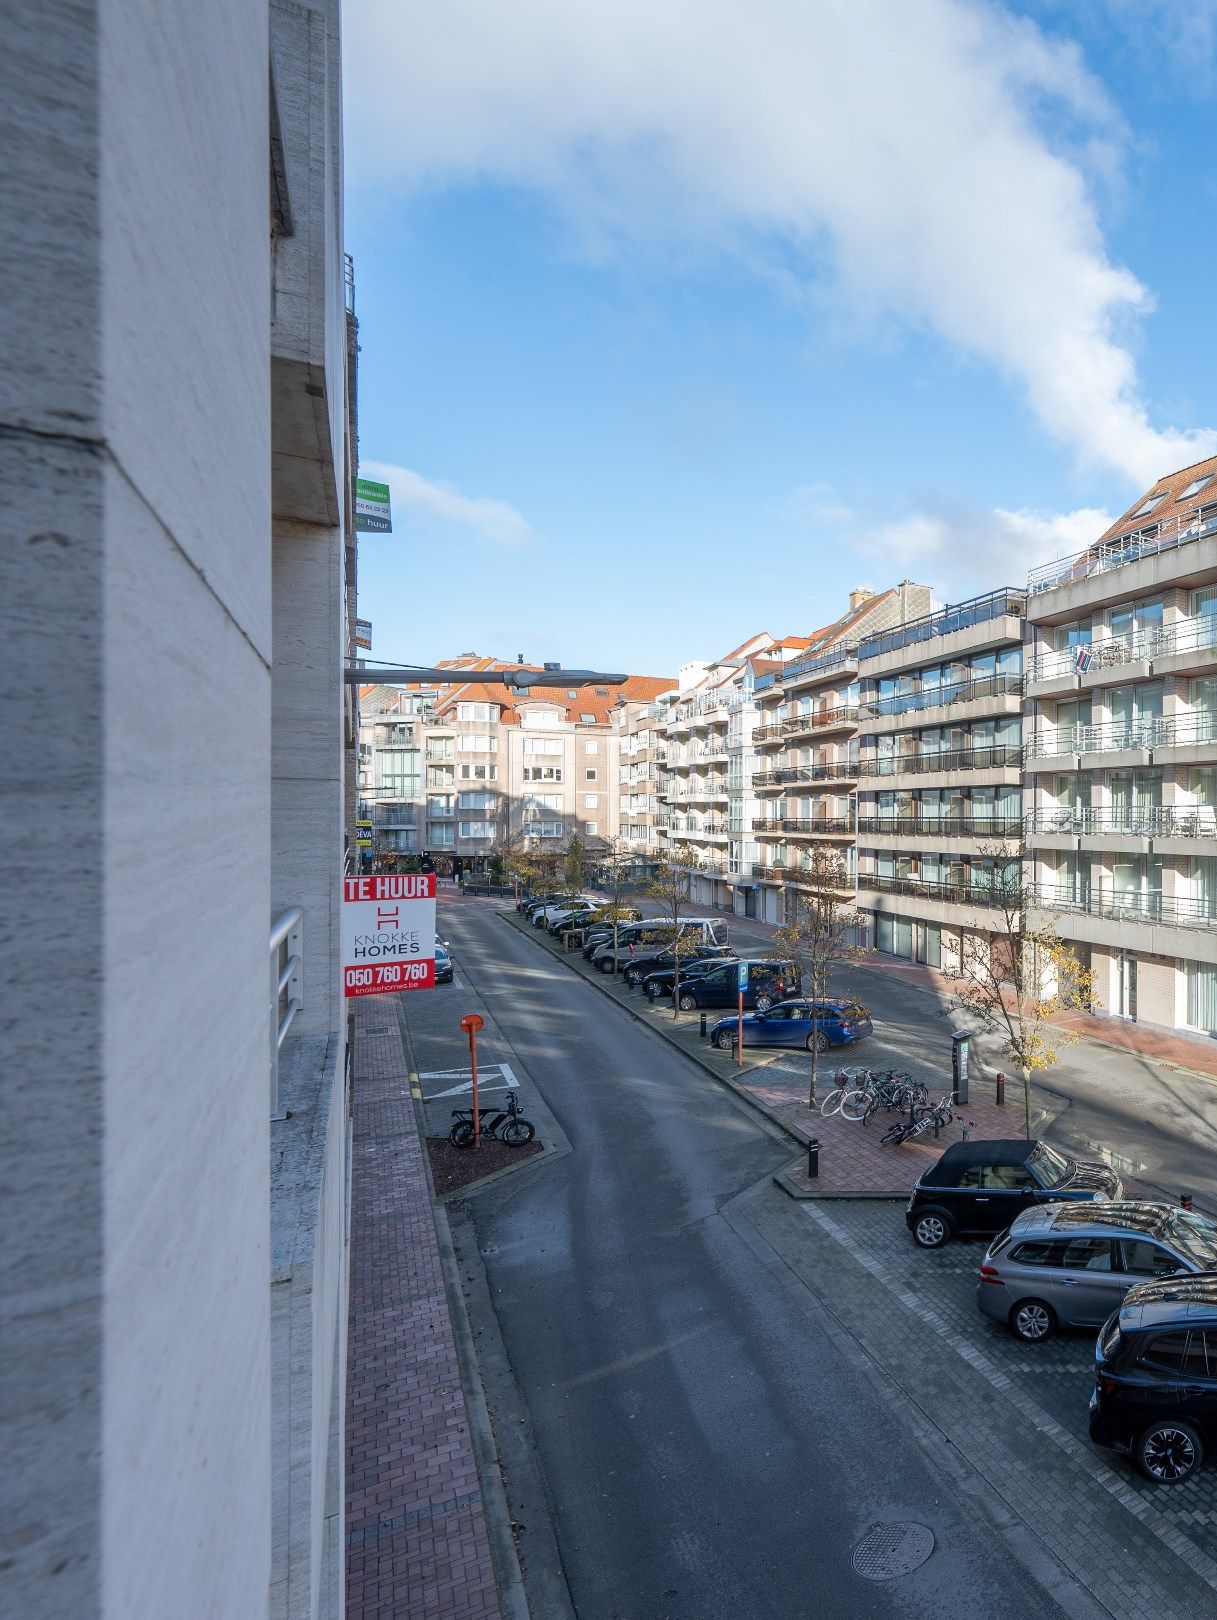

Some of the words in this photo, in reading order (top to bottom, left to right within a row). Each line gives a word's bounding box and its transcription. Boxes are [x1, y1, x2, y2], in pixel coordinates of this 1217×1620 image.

[367, 518, 388, 528] huur
[345, 877, 371, 900] TE
[376, 876, 429, 899] HUUR
[354, 930, 420, 946] KNOKKE
[354, 942, 420, 959] HOMES
[346, 968, 373, 988] 050
[375, 965, 401, 984] 760
[402, 962, 428, 981] 760
[740, 966, 747, 983] P
[355, 981, 419, 995] knokkehomes.be
